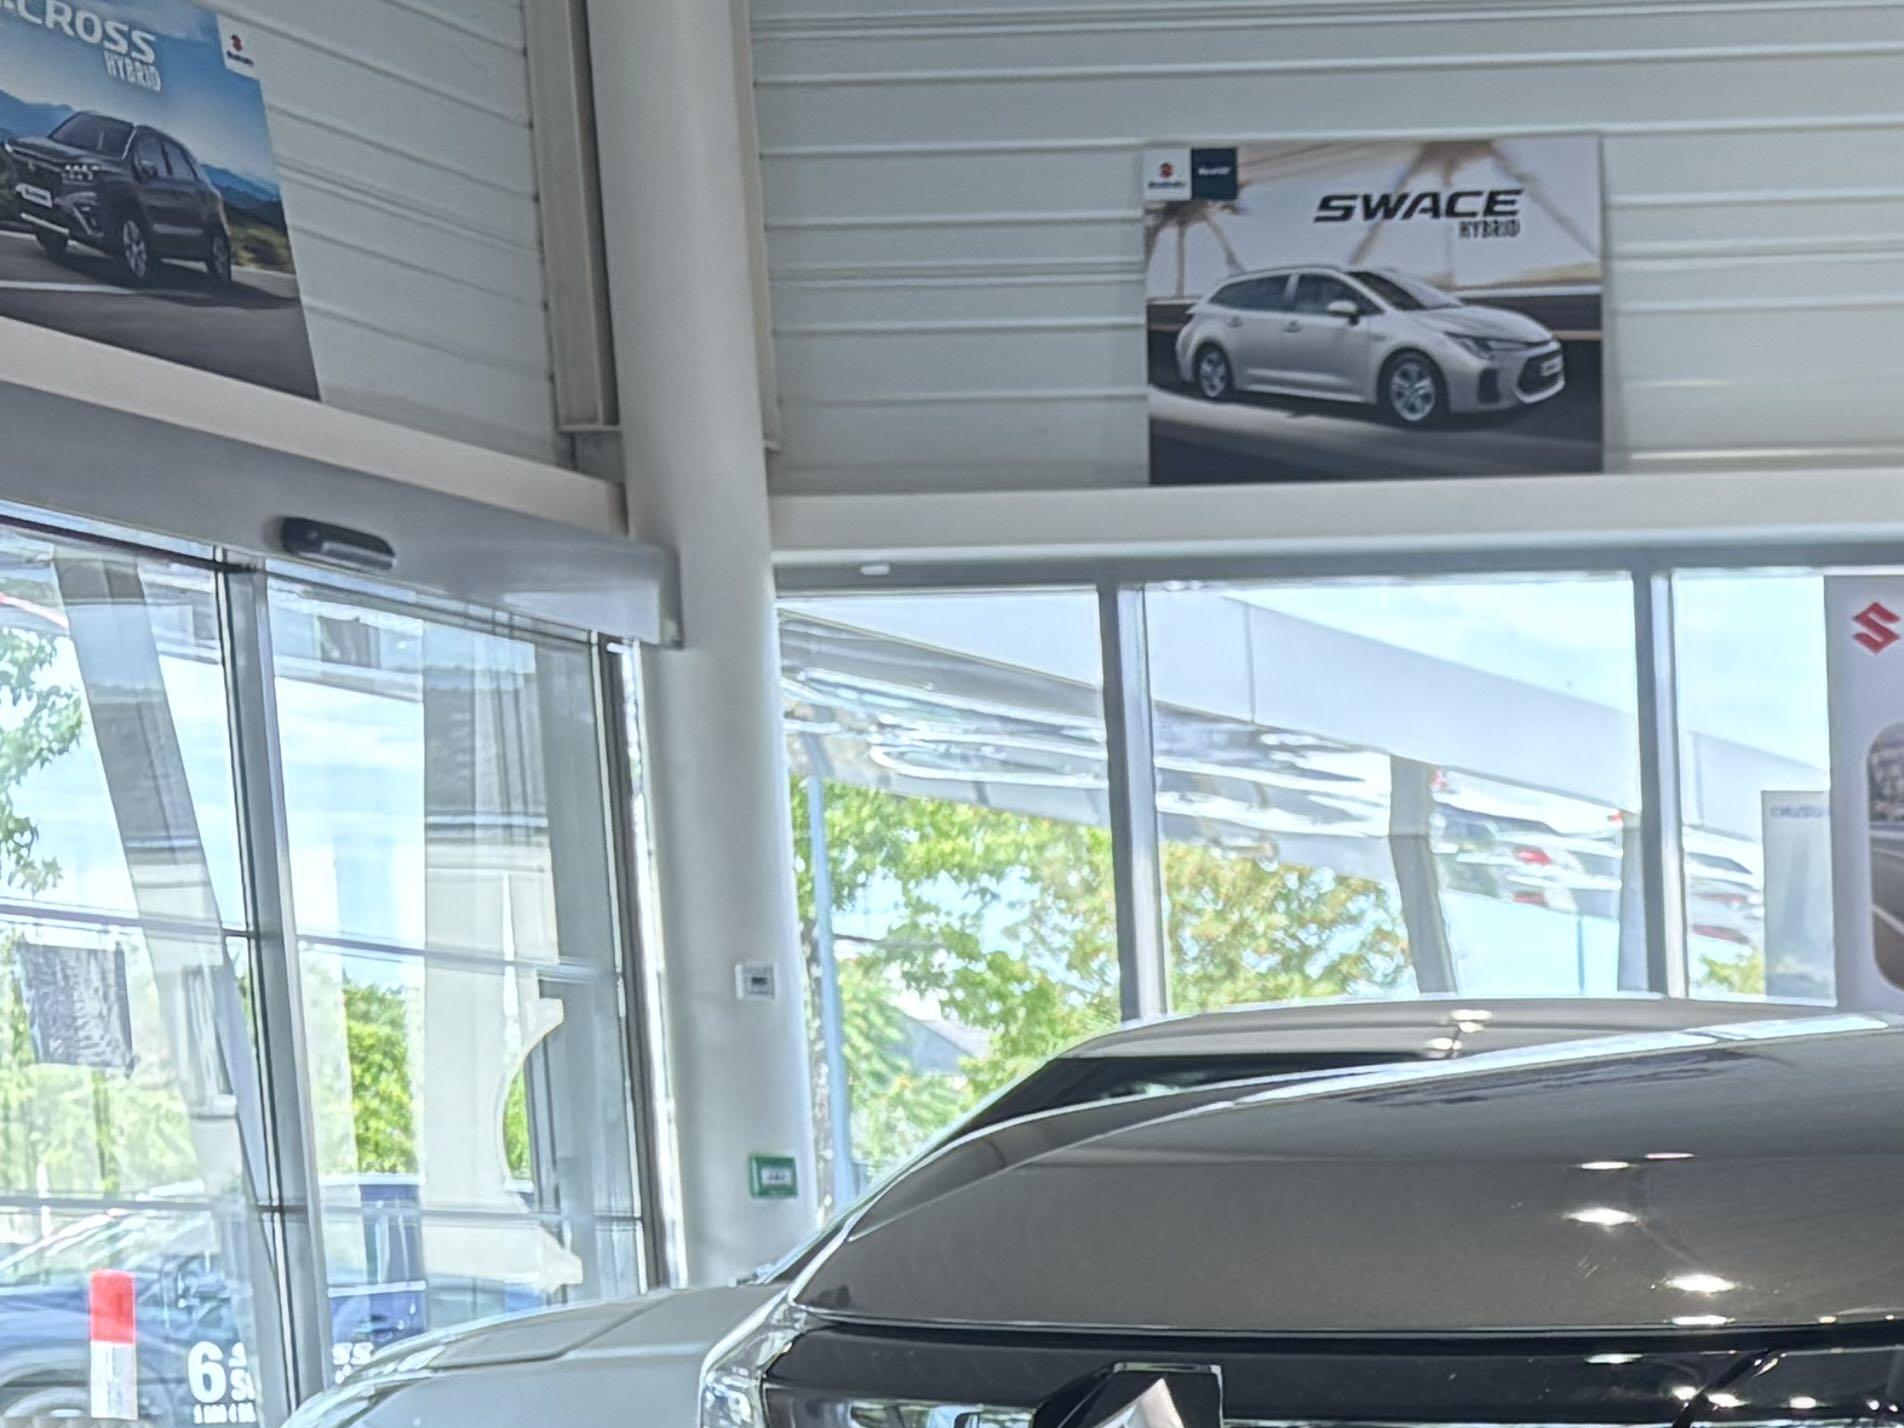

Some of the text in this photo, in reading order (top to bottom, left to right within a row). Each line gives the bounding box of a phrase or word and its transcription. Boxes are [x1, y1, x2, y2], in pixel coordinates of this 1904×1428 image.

[0, 0, 156, 64] CROSS
[103, 50, 161, 91] HYBRID
[1313, 188, 1524, 223] SWACE
[1458, 218, 1521, 239] HYBRID
